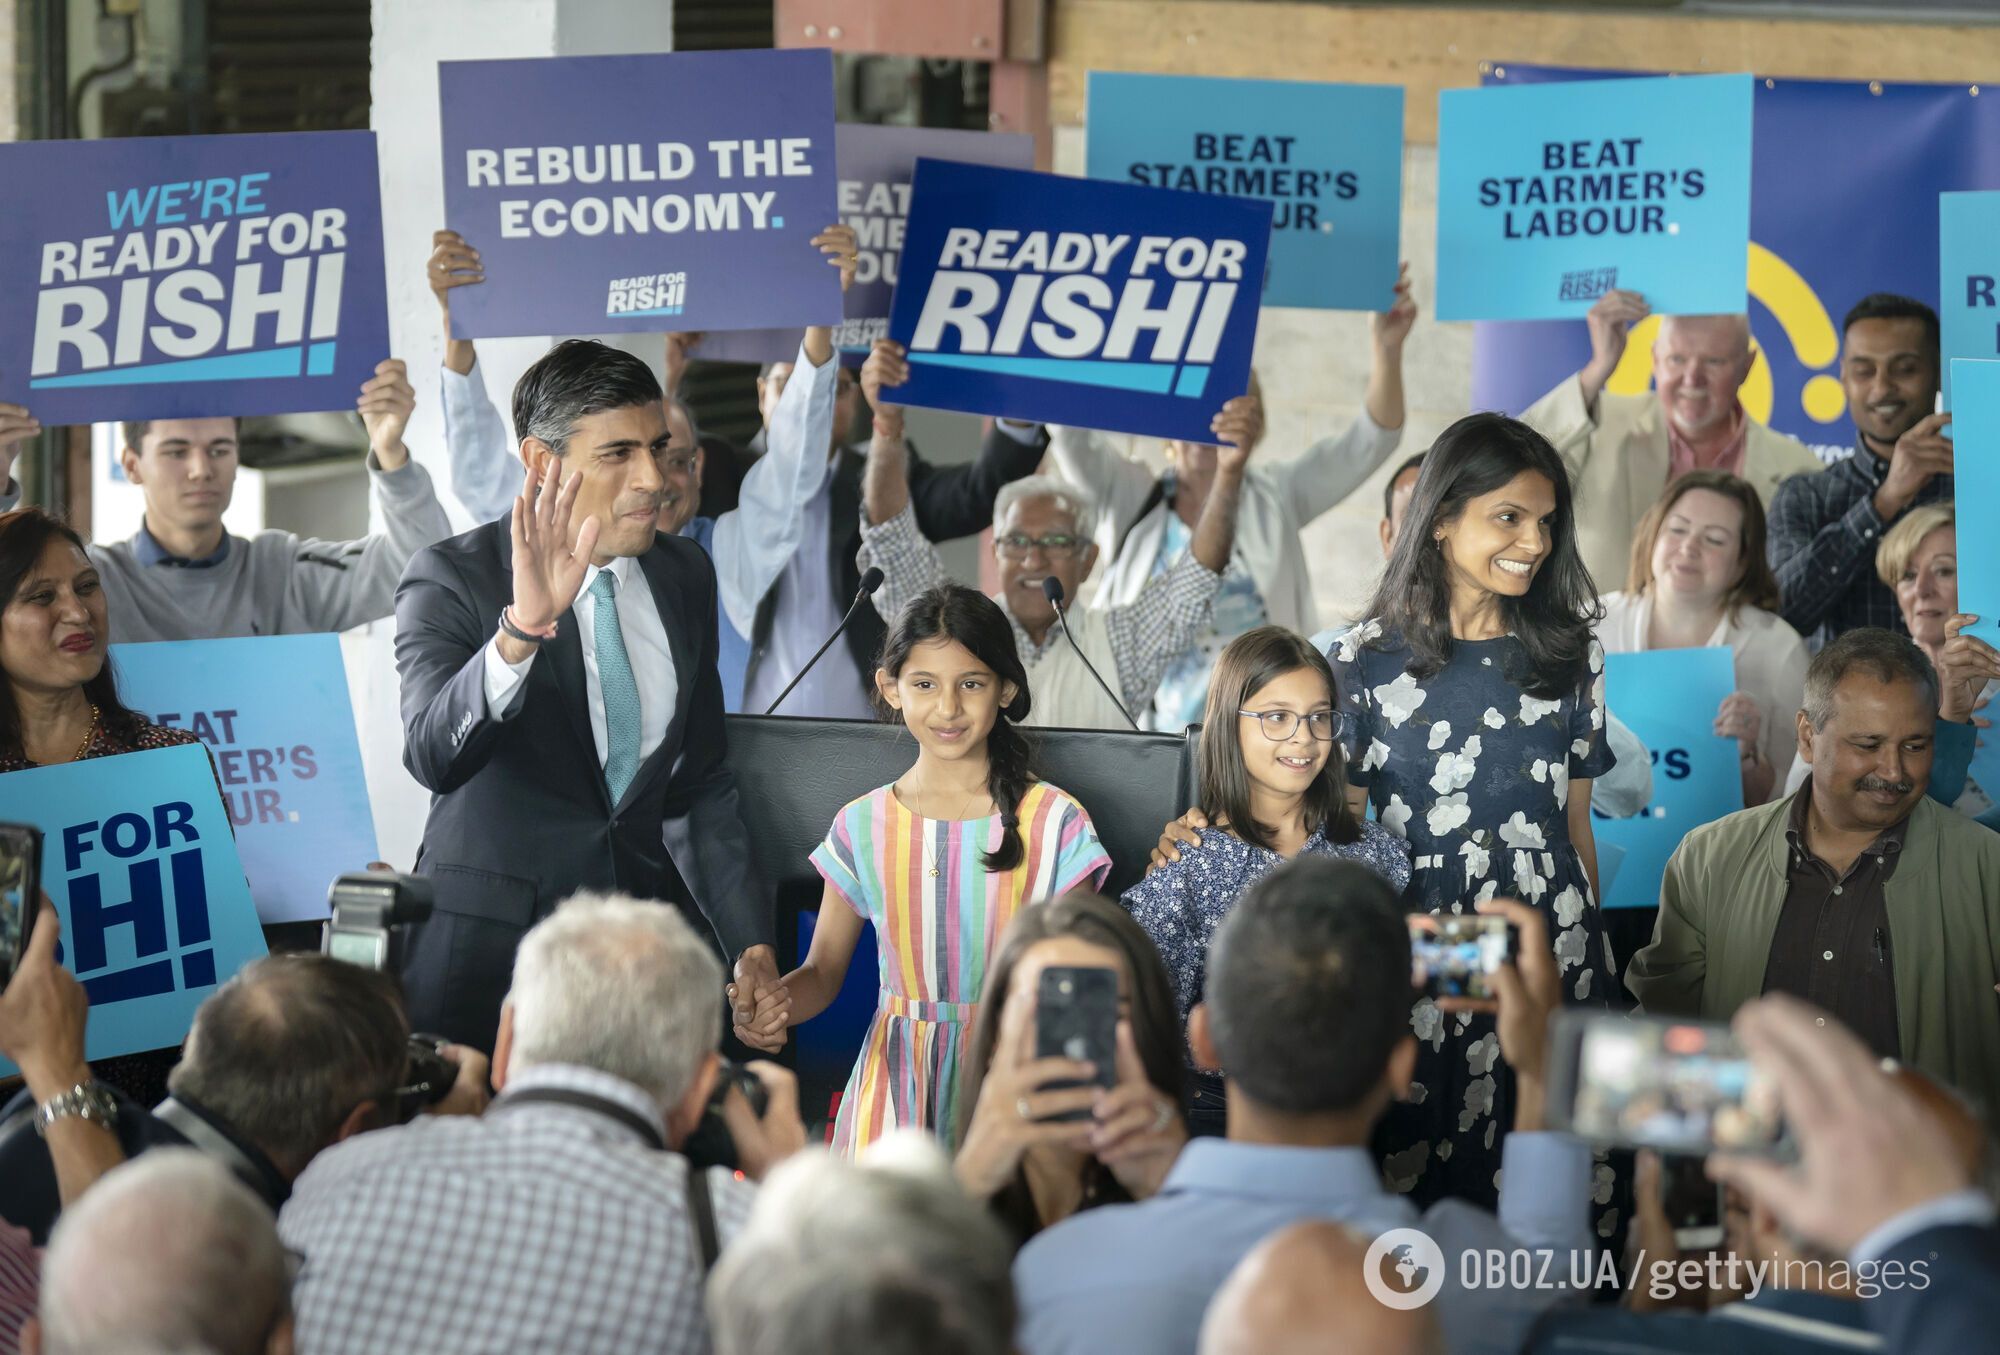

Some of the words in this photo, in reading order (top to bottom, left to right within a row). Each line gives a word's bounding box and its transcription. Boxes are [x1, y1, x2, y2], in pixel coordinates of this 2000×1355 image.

[466, 143, 695, 187] REBUILD
[708, 138, 813, 178] THE
[1193, 133, 1295, 164] BEAT
[1542, 139, 1642, 170] BEAT
[838, 180, 912, 216] EAT
[1478, 170, 1706, 206] STARMER'S
[500, 191, 784, 238] ECONOMY.
[1504, 206, 1680, 239] LABOUR.
[40, 220, 227, 285] READY
[235, 208, 347, 261] FOR
[938, 228, 1129, 274] READY
[1129, 236, 1247, 280] FOR
[609, 275, 656, 291] READY
[657, 272, 686, 285] FOR
[62, 801, 200, 872] FOR
